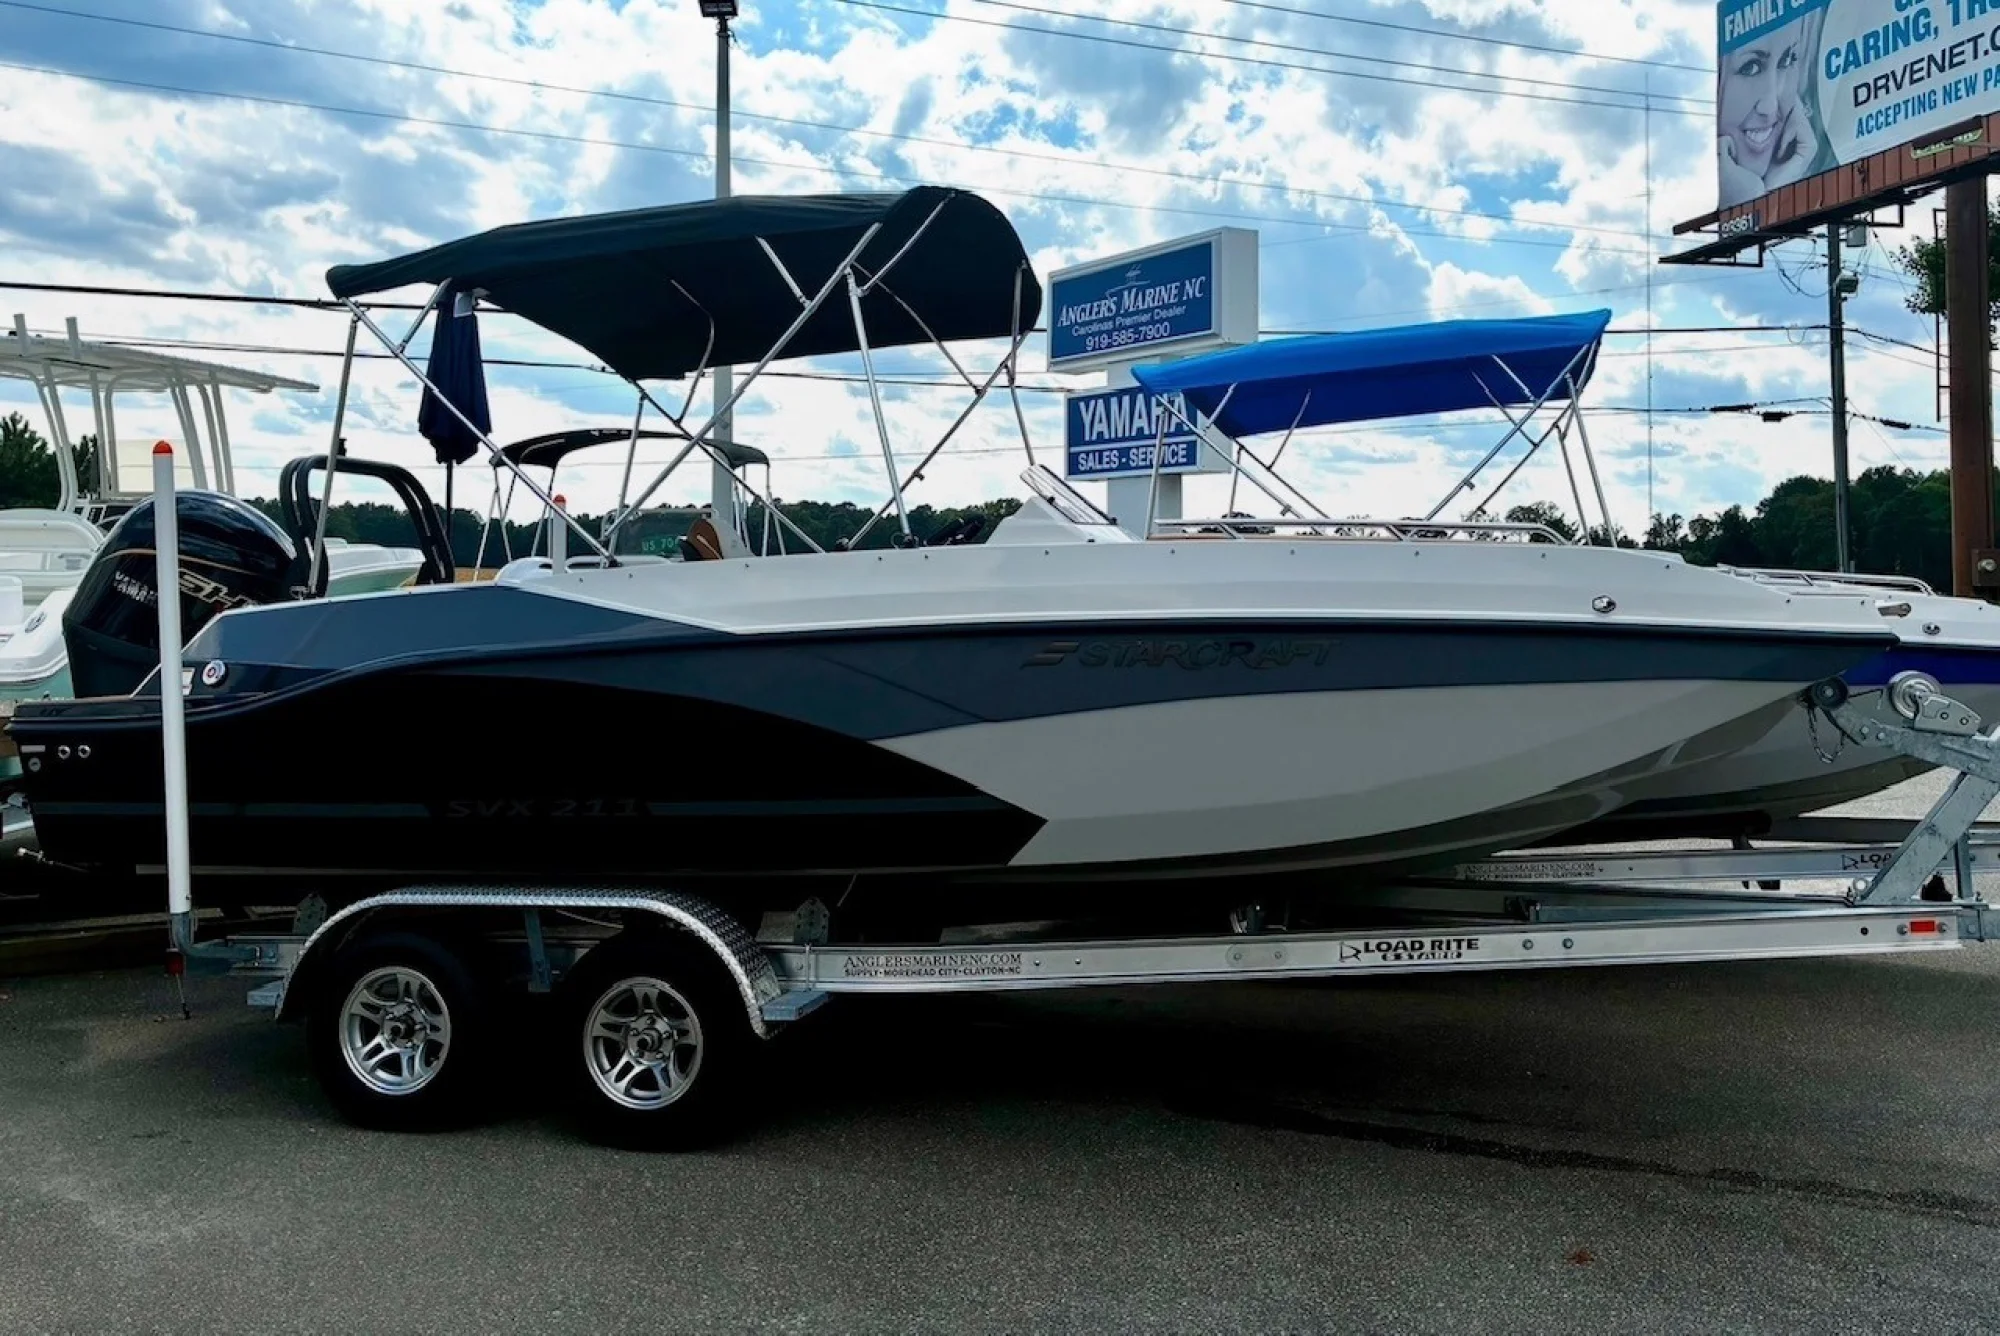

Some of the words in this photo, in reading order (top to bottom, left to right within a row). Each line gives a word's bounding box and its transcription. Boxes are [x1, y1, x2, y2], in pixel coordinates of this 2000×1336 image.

[1724, 0, 1785, 42] FAMILY
[1824, 7, 1940, 80] CARING,
[1855, 89, 1937, 139] ACCEPTING
[1941, 73, 1978, 105] NEW
[1120, 283, 1180, 314] MARINE
[1183, 276, 1206, 301] NC
[1116, 312, 1151, 329] Premier
[1155, 304, 1187, 320] Dealer
[1086, 322, 1171, 351] 919-585-7900
[1078, 392, 1190, 442] YAMAHA
[1078, 450, 1120, 471] SALES
[1078, 639, 1343, 670] STARCRAFT
[445, 799, 534, 818] SVX
[550, 798, 640, 817] 211
[844, 952, 1022, 968] ANGLERSMARINENC.COM
[1363, 940, 1426, 954] LOAD
[1430, 938, 1480, 951] RITE
